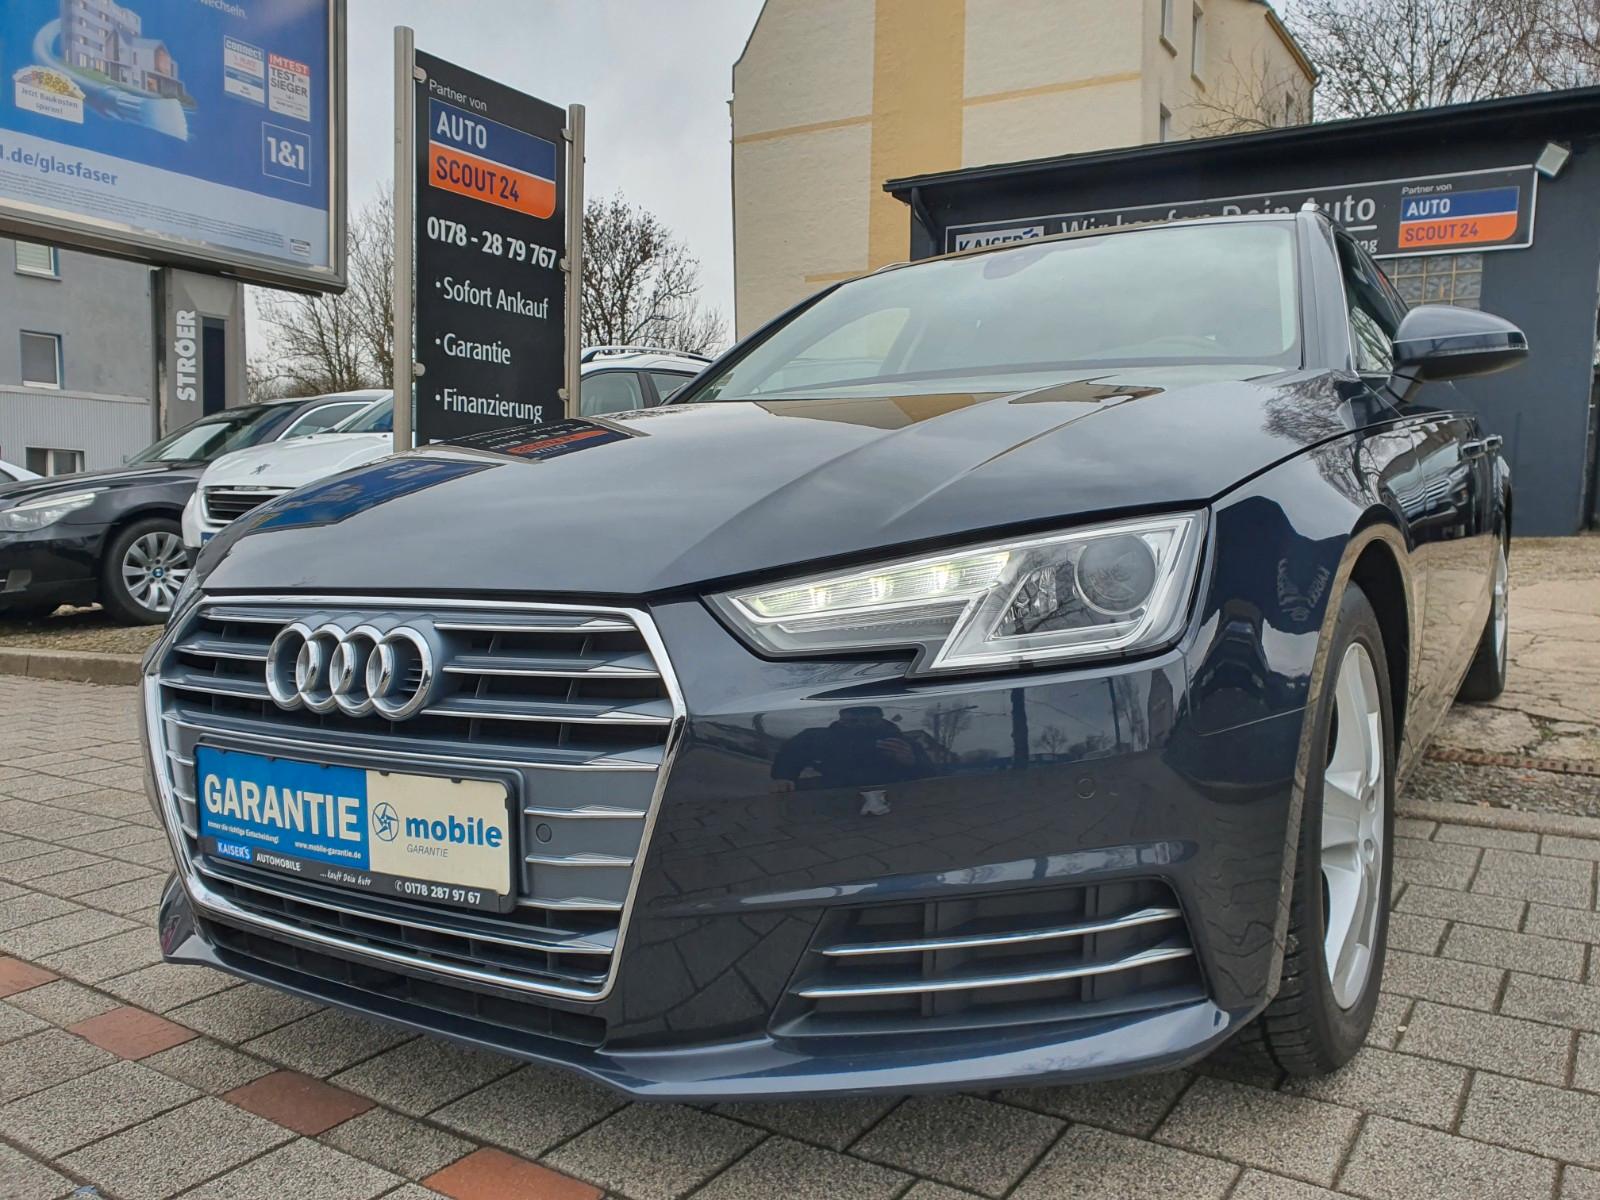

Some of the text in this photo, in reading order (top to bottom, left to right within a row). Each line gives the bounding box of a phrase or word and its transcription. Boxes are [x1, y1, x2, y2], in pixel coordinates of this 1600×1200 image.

[270, 78, 308, 98] SIEGER
[429, 78, 487, 112] Partner von
[436, 111, 487, 149] AUTO
[266, 137, 305, 171] 1&1
[1402, 183, 1452, 195] Partner von
[1407, 198, 1451, 217] AUTO
[427, 216, 467, 247] 0178
[481, 231, 503, 256] 28
[507, 238, 526, 262] 79
[530, 244, 557, 270] 767
[496, 289, 549, 319] Ankauf
[174, 310, 196, 402] STRÖER
[204, 773, 361, 842] GARANTIE
[405, 815, 503, 848] mobile
[256, 853, 301, 872] AUTOMOBILE
[406, 844, 448, 858] GARANTIE
[357, 875, 371, 887] Auto
[405, 882, 481, 905] 0178 287 97 67
